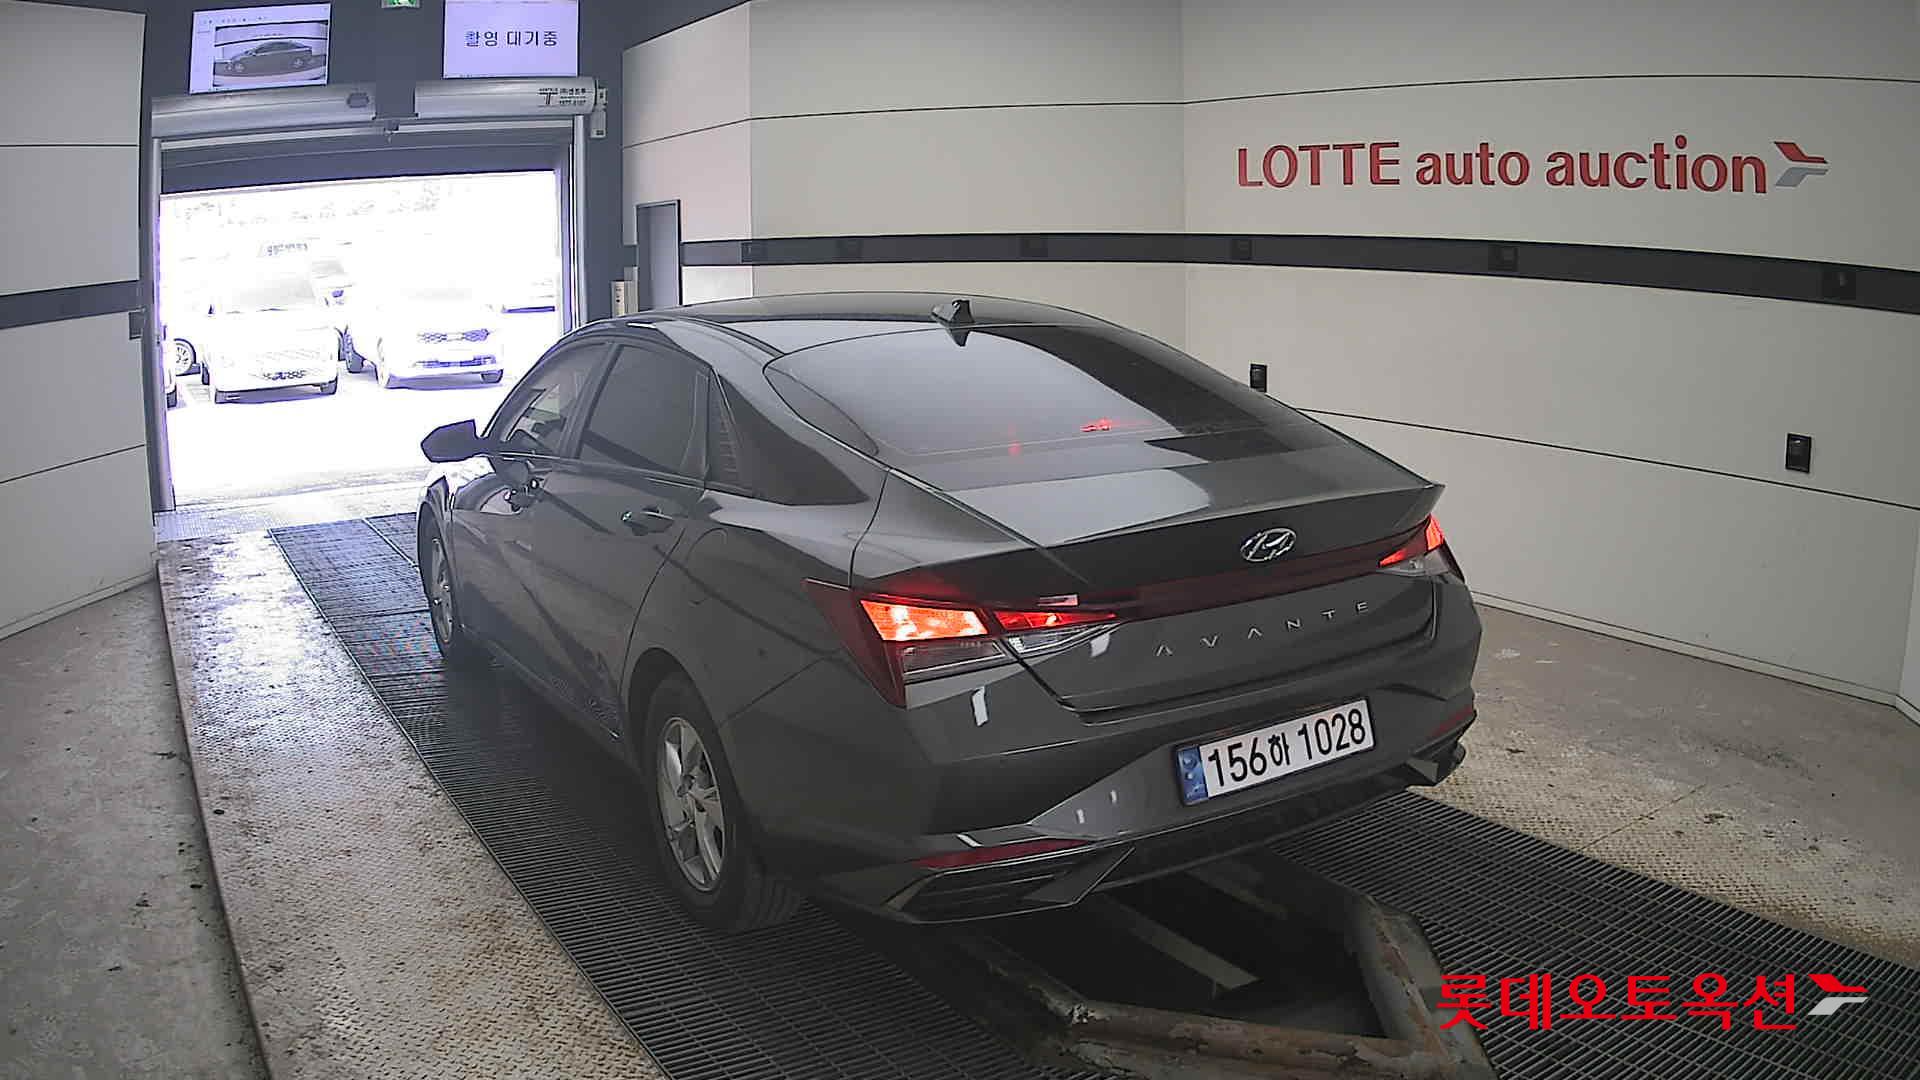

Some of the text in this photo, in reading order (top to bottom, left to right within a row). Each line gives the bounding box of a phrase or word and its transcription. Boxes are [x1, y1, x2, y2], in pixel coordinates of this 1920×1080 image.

[1237, 135, 1768, 194] LOTTE auto auction
[1155, 601, 1369, 656] AVANTE
[1208, 708, 1366, 787] 156하 1028
